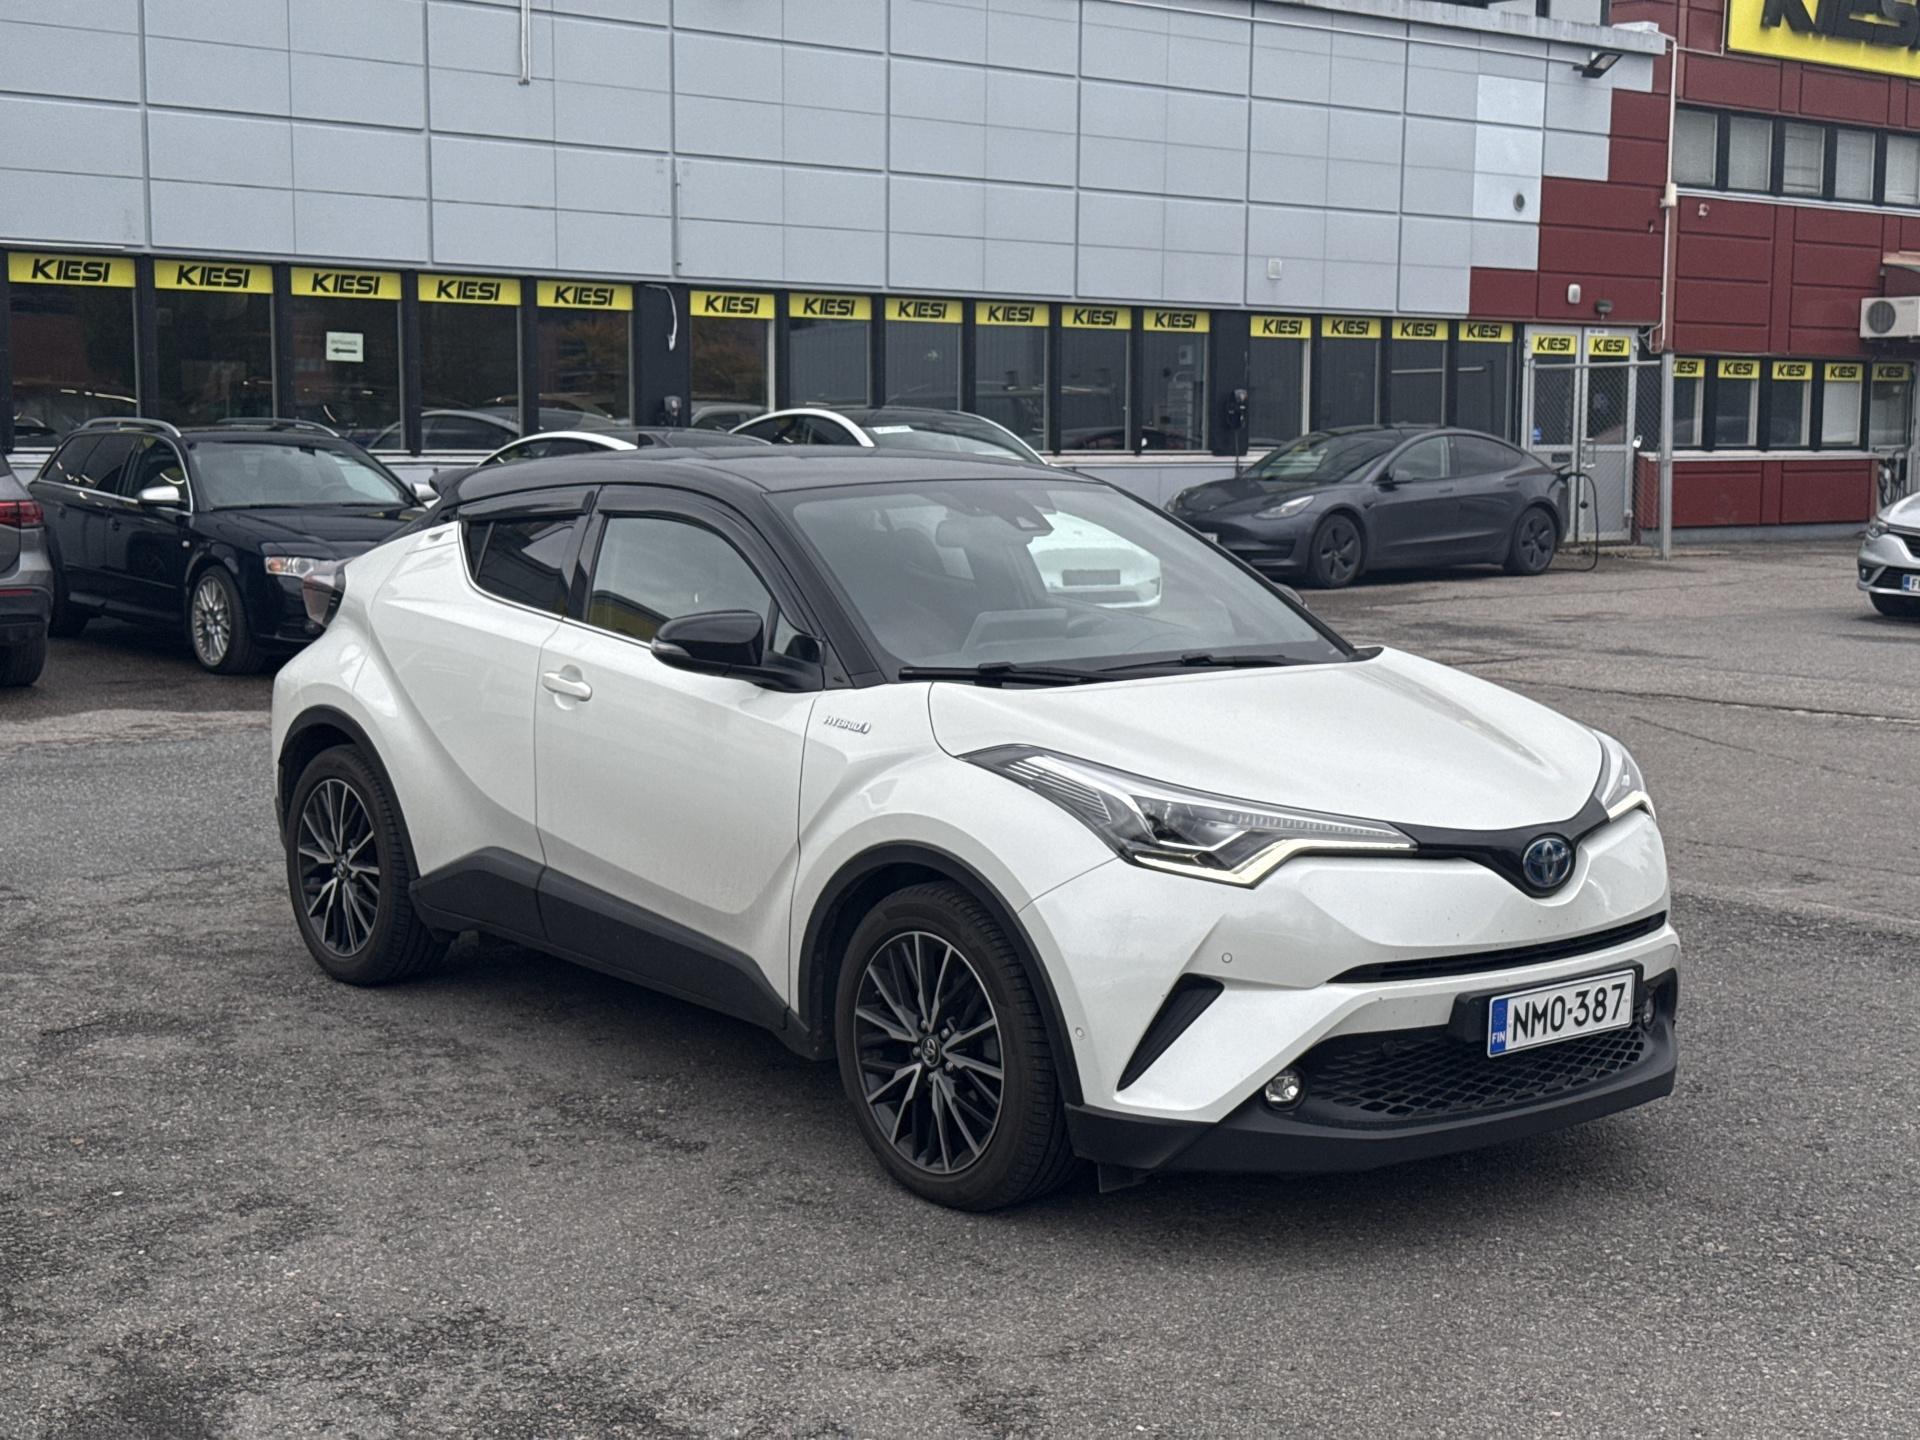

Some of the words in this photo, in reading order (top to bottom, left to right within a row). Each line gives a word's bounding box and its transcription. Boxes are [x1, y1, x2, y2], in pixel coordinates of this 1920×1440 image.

[32, 258, 111, 283] KIESI
[177, 264, 251, 289] KIESI
[312, 273, 381, 295] KIESI
[437, 280, 501, 302] KIESI
[554, 285, 614, 306] KIESI
[704, 294, 760, 315] KIESI
[803, 297, 855, 317] KIESI
[898, 300, 947, 320] KIESI
[987, 303, 1034, 323] KIESI
[1072, 308, 1118, 327] KIESI
[1154, 312, 1197, 329] KIESI
[1263, 319, 1303, 335] KIESI
[1331, 319, 1370, 336] KIESI
[1400, 321, 1437, 337] KIESI
[1467, 323, 1502, 338] KIESI
[1537, 337, 1571, 351] KIESI
[1593, 339, 1624, 353] KIESI
[1724, 361, 1753, 375] KIESI
[1778, 363, 1806, 377] KIESI
[1829, 365, 1857, 378] KIESI
[1877, 366, 1904, 379] KIESI
[1513, 982, 1626, 1042] NMO-387
[1492, 1031, 1505, 1045] FIN
